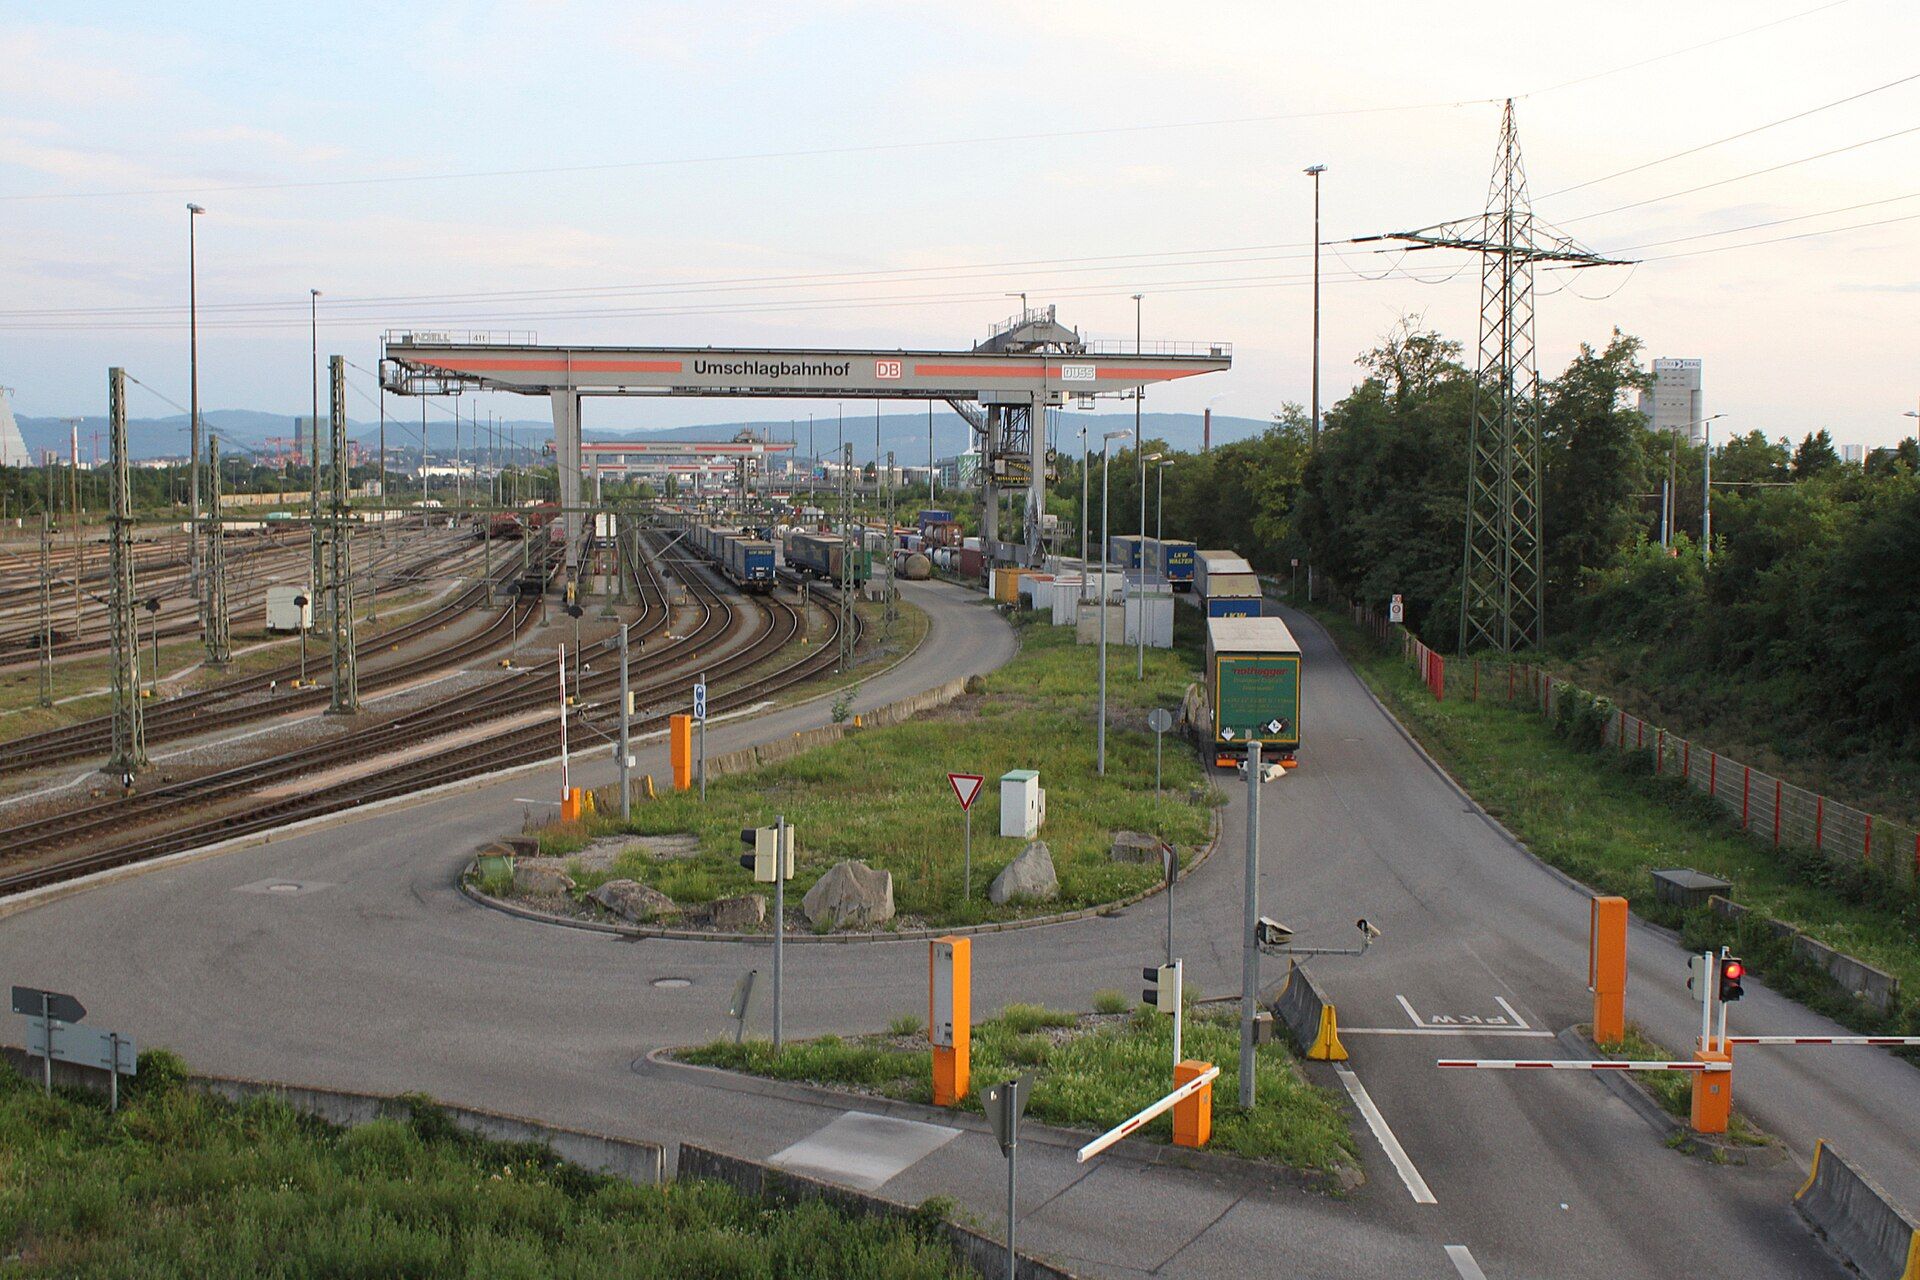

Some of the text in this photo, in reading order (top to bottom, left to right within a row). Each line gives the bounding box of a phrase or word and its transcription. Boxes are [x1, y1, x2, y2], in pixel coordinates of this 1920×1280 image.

[694, 360, 850, 378] Umschlagbahnhof
[877, 362, 900, 377] DB
[1064, 367, 1094, 379] DUSS
[1431, 1014, 1508, 1025] PKW
